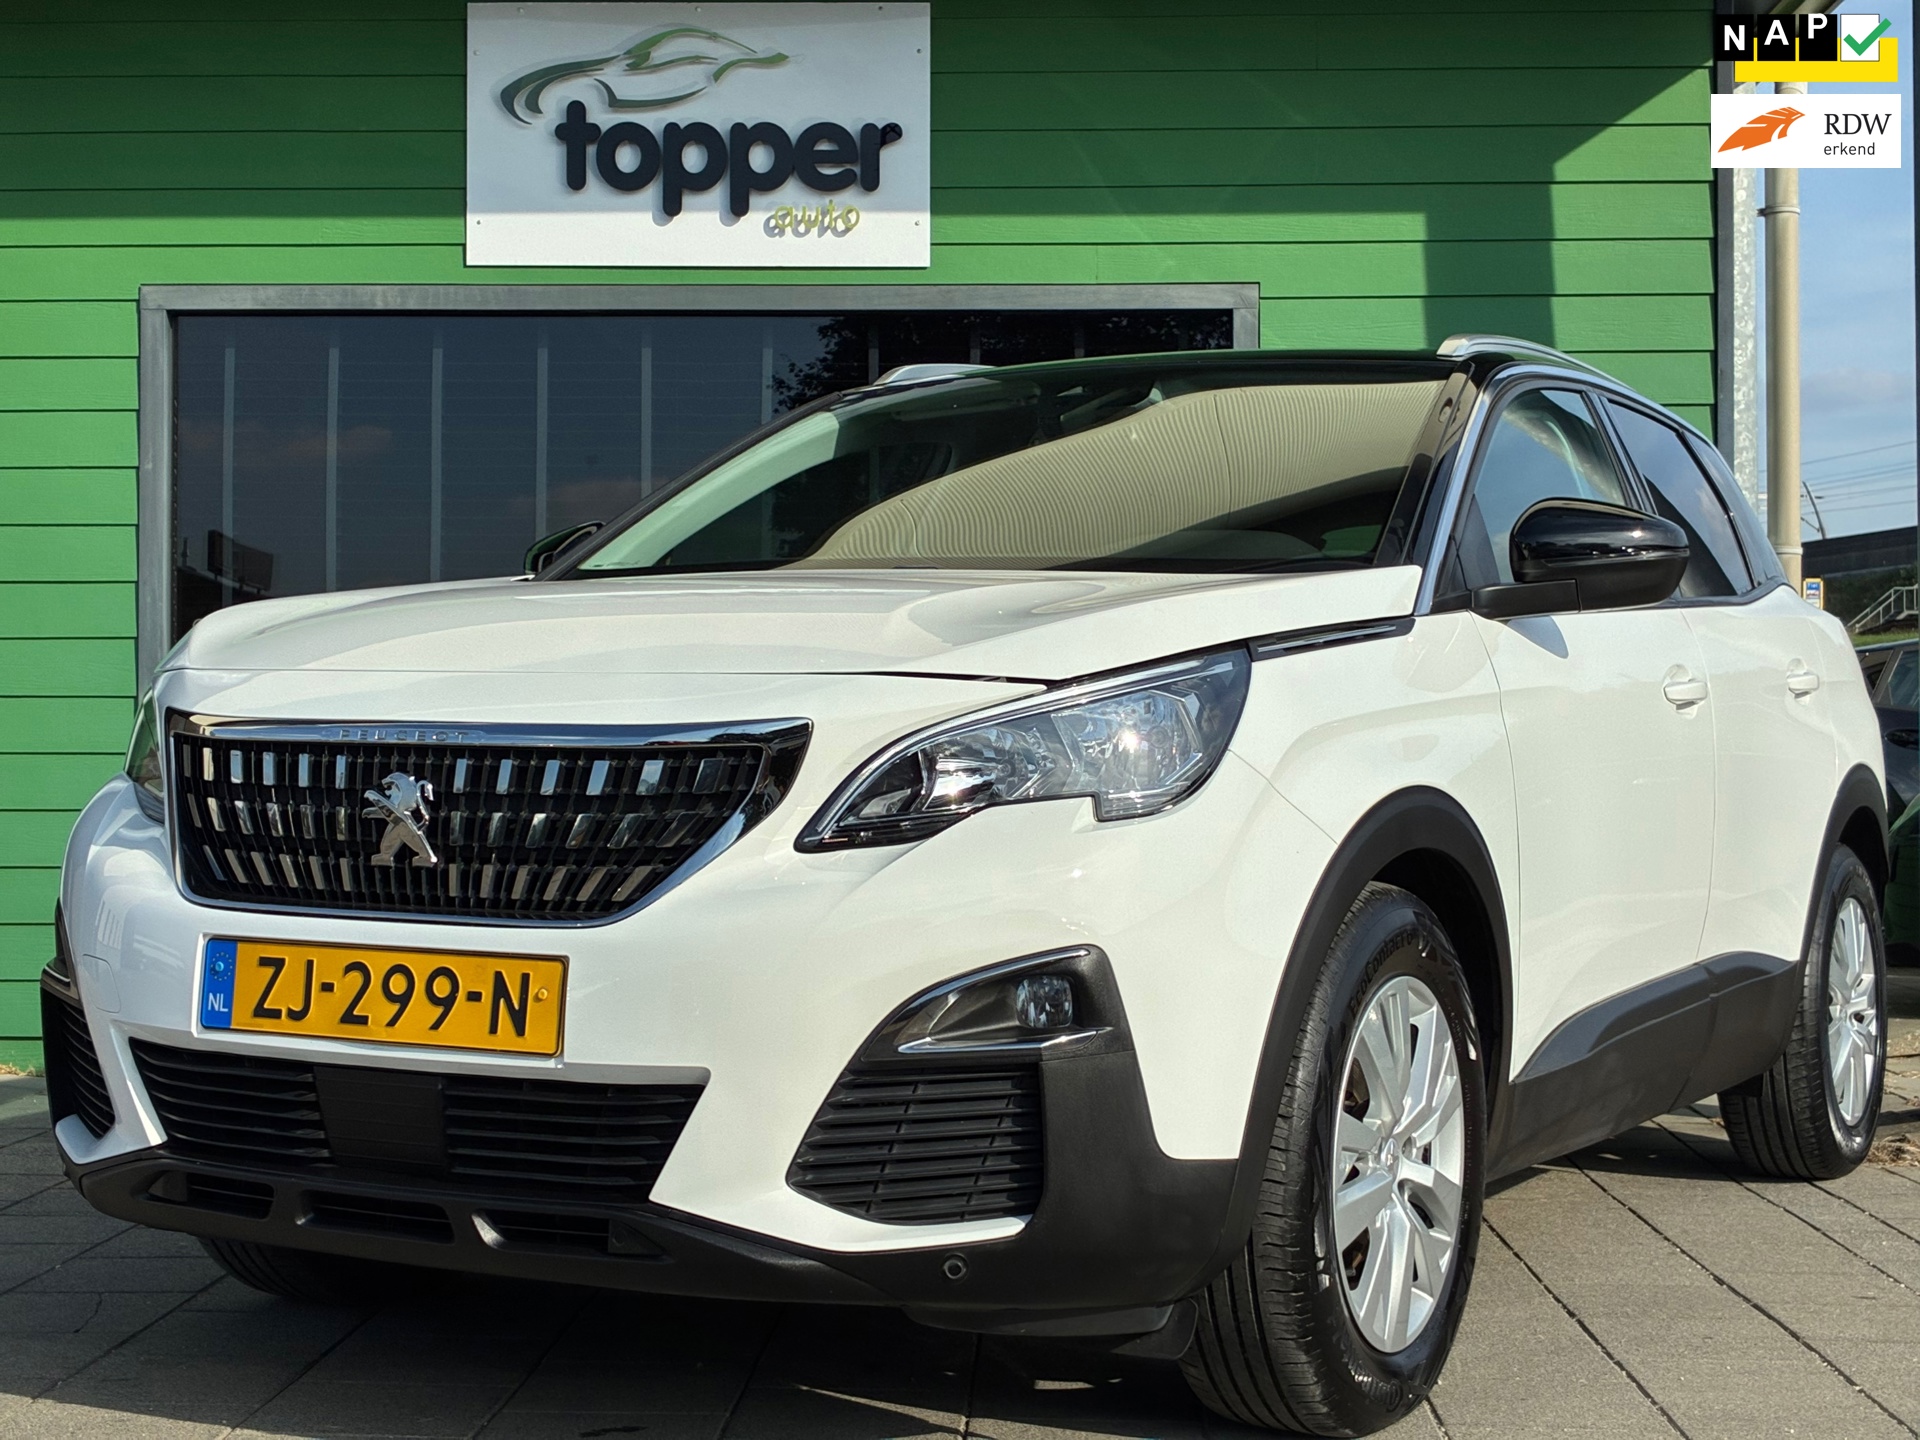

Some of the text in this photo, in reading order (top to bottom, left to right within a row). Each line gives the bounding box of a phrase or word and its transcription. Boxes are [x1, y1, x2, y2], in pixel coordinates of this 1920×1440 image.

[554, 100, 904, 217] topper
[773, 199, 861, 230] auto
[339, 728, 470, 743] PEUGEOT
[207, 992, 229, 1013] NL
[252, 955, 532, 1037] ZJ-299-N
